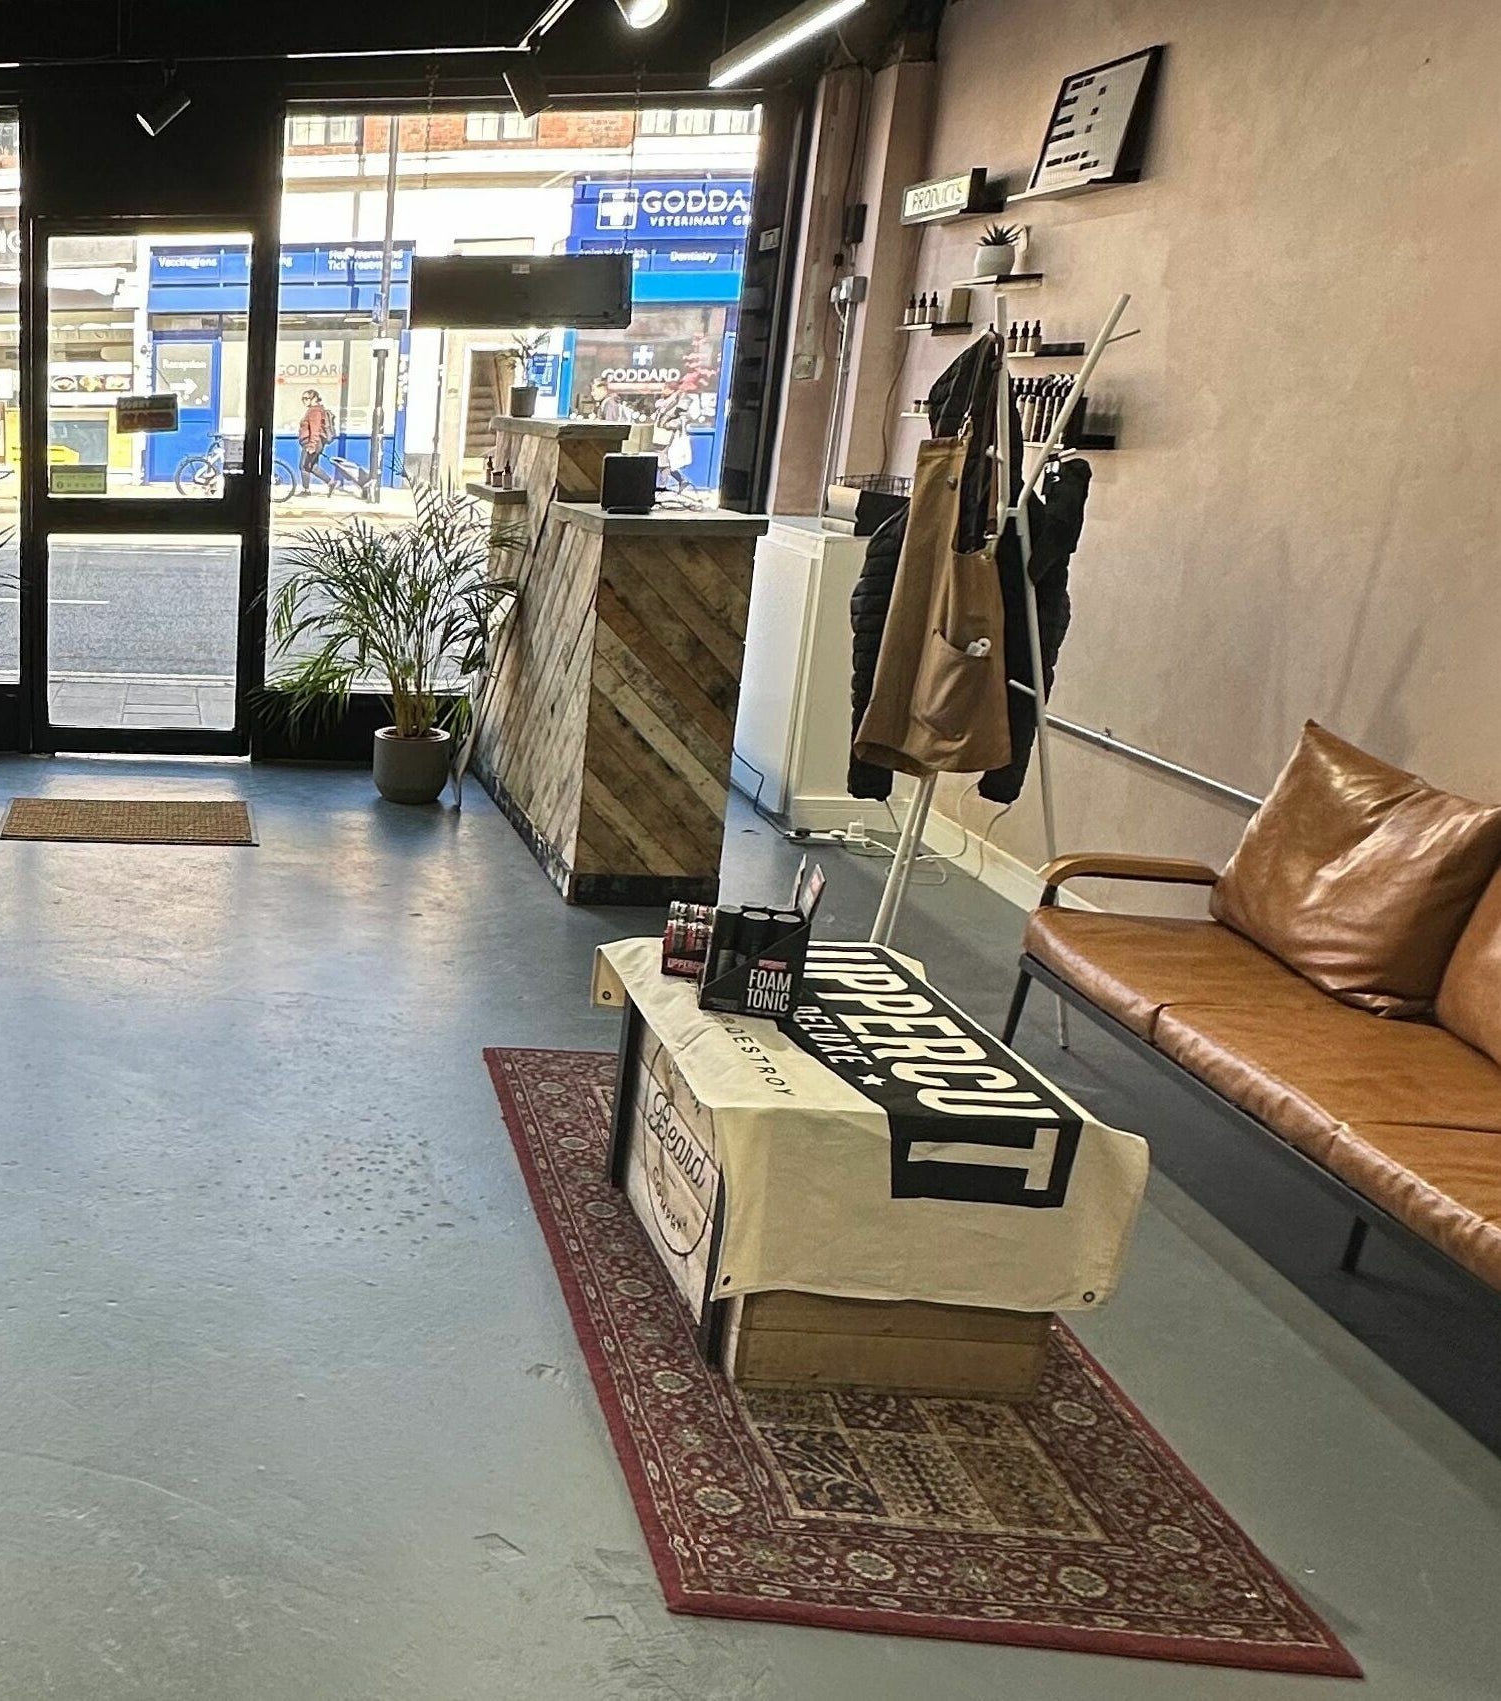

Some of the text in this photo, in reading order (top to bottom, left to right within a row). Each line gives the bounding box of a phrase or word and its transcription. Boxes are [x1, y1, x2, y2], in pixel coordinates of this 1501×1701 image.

[650, 216, 727, 227] VETERINARY
[278, 363, 341, 377] GODDAR
[601, 368, 681, 383] GODDARD
[749, 968, 793, 993] FOAM
[747, 988, 791, 1013] TONIC
[793, 1005, 874, 1065] DELUXE
[725, 1026, 796, 1096] DESTROY
[802, 947, 1060, 1190] UPPERCUT
[648, 1091, 706, 1189] Beard
